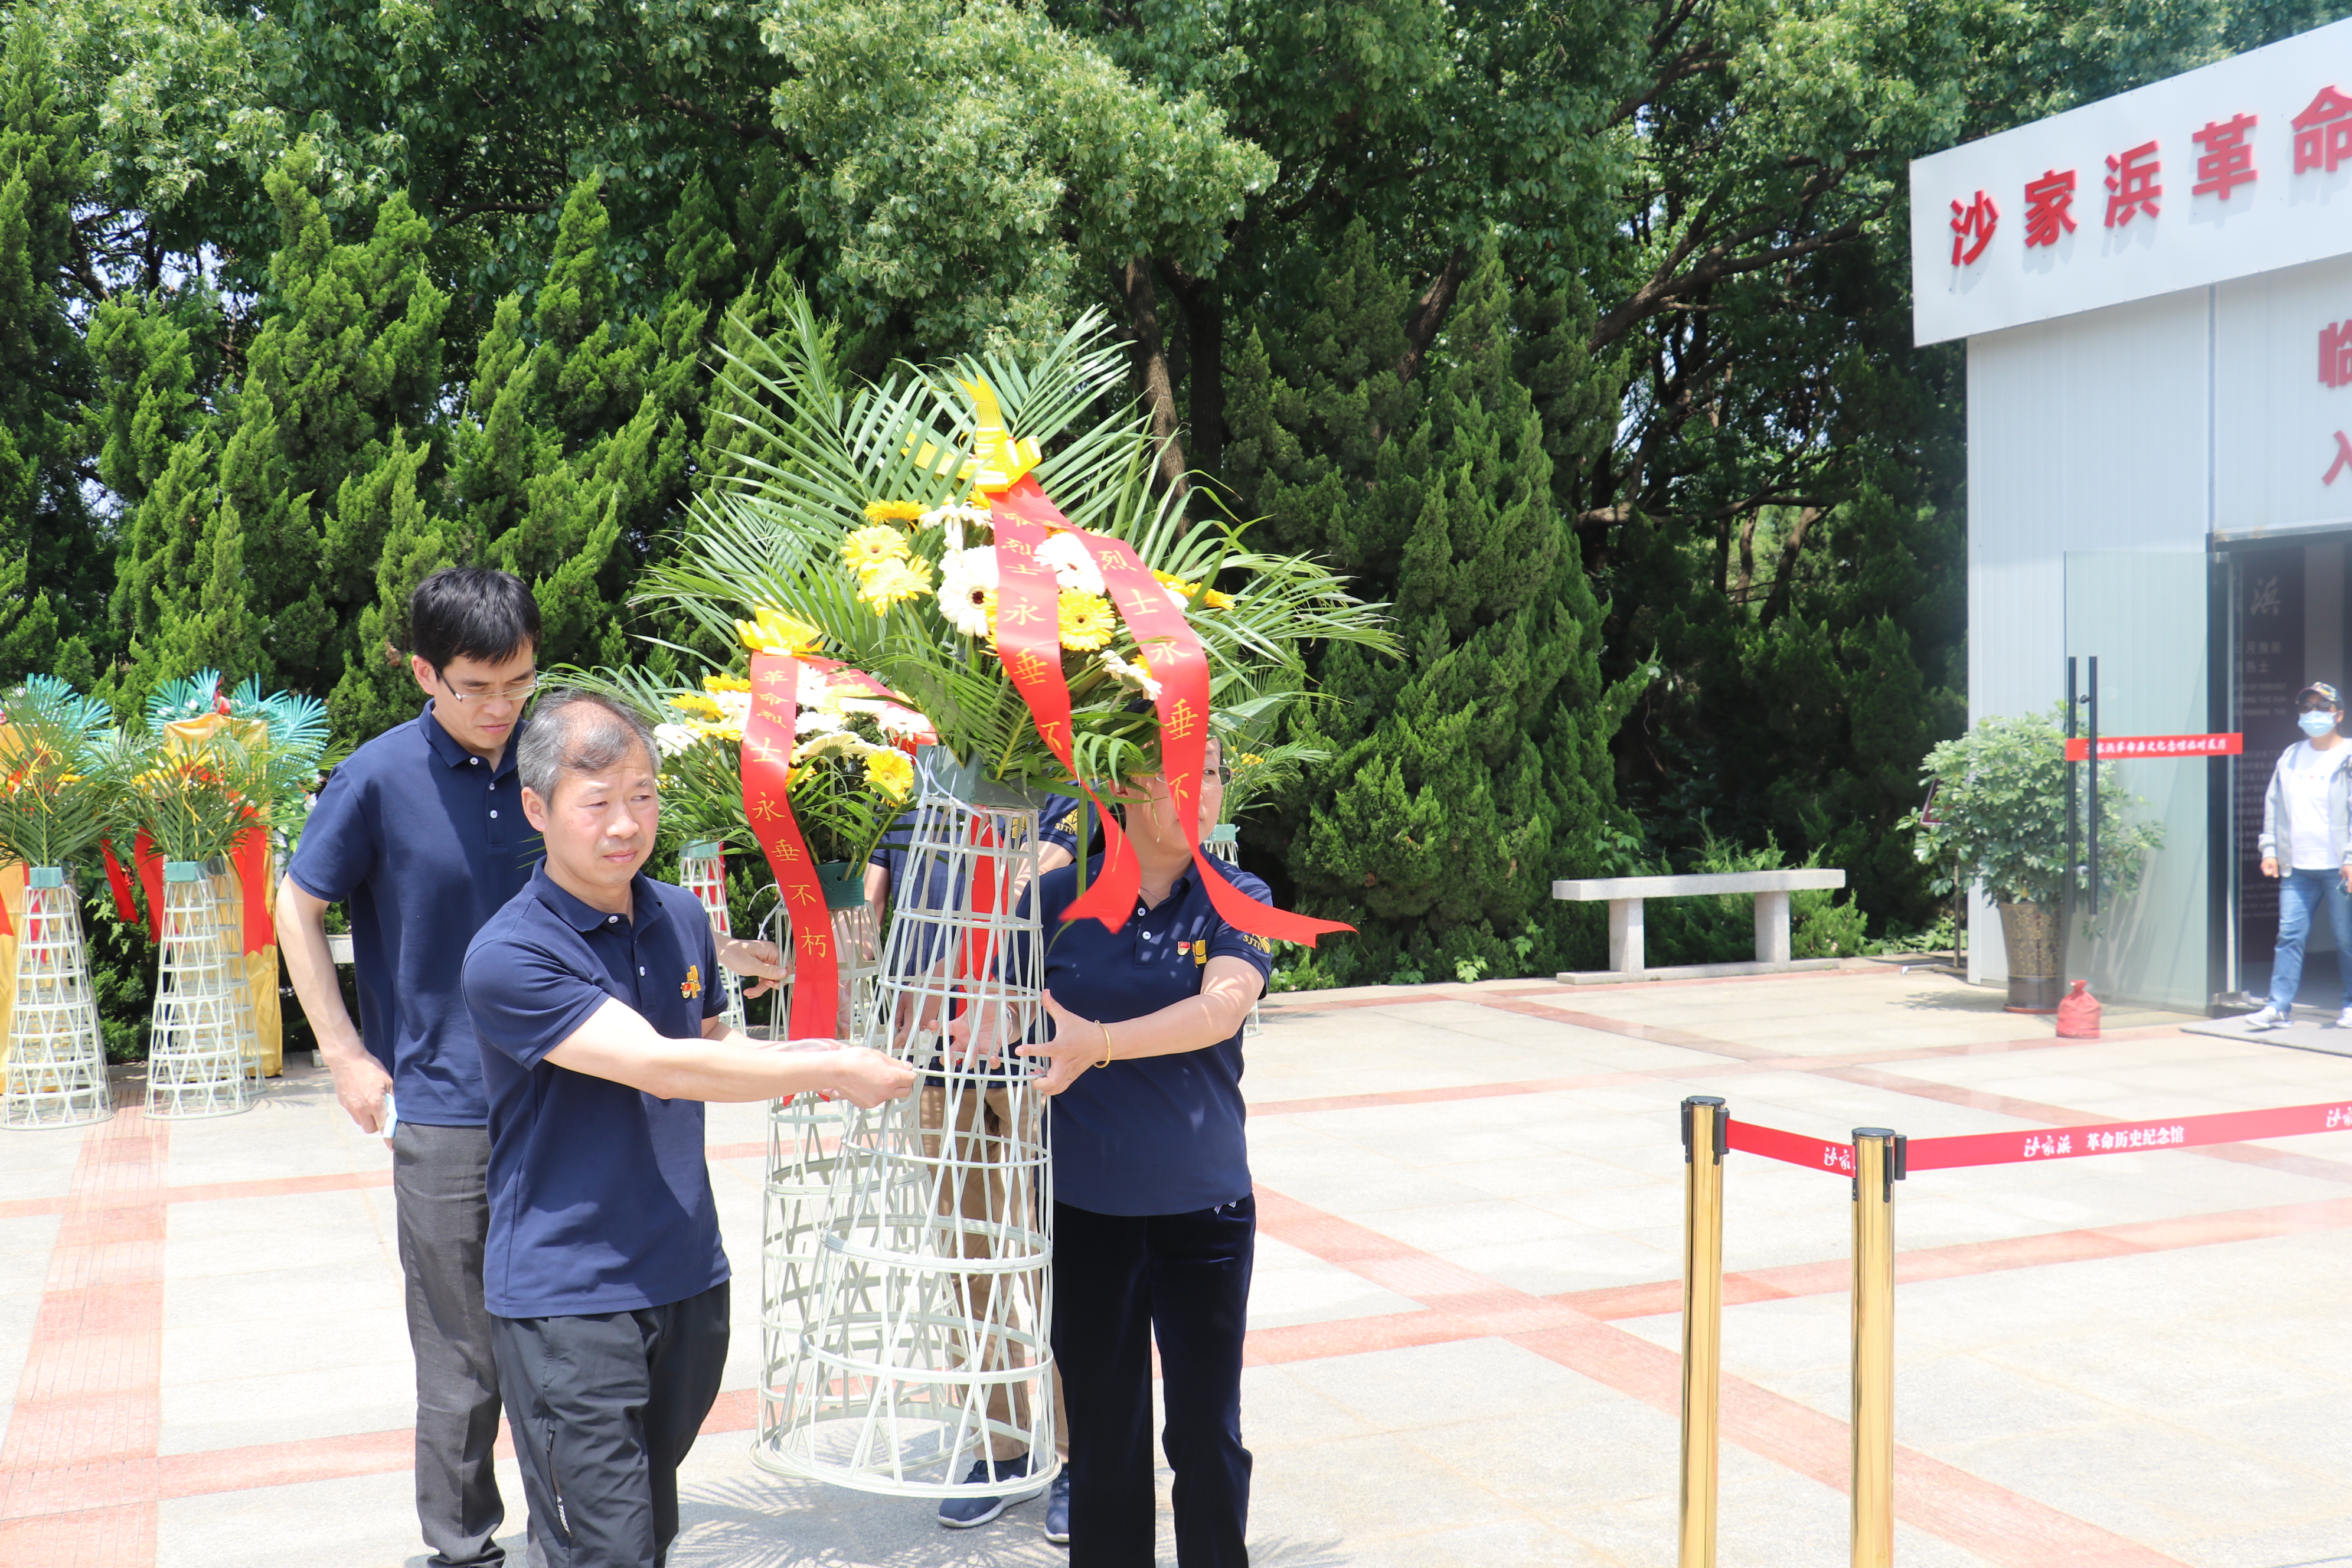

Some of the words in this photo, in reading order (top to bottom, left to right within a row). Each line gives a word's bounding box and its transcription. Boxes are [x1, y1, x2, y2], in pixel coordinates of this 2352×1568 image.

[1949, 84, 2352, 267] 沙家浜革命
[749, 669, 828, 958] 革命烈士永垂不朽
[1054, 822, 1074, 835] SJTU
[1242, 934, 1262, 952] SJTU
[2023, 1134, 2072, 1158] 沙家浜
[2086, 1125, 2185, 1151] 革命历史纪念馆
[1824, 1146, 1856, 1170] 沙家
